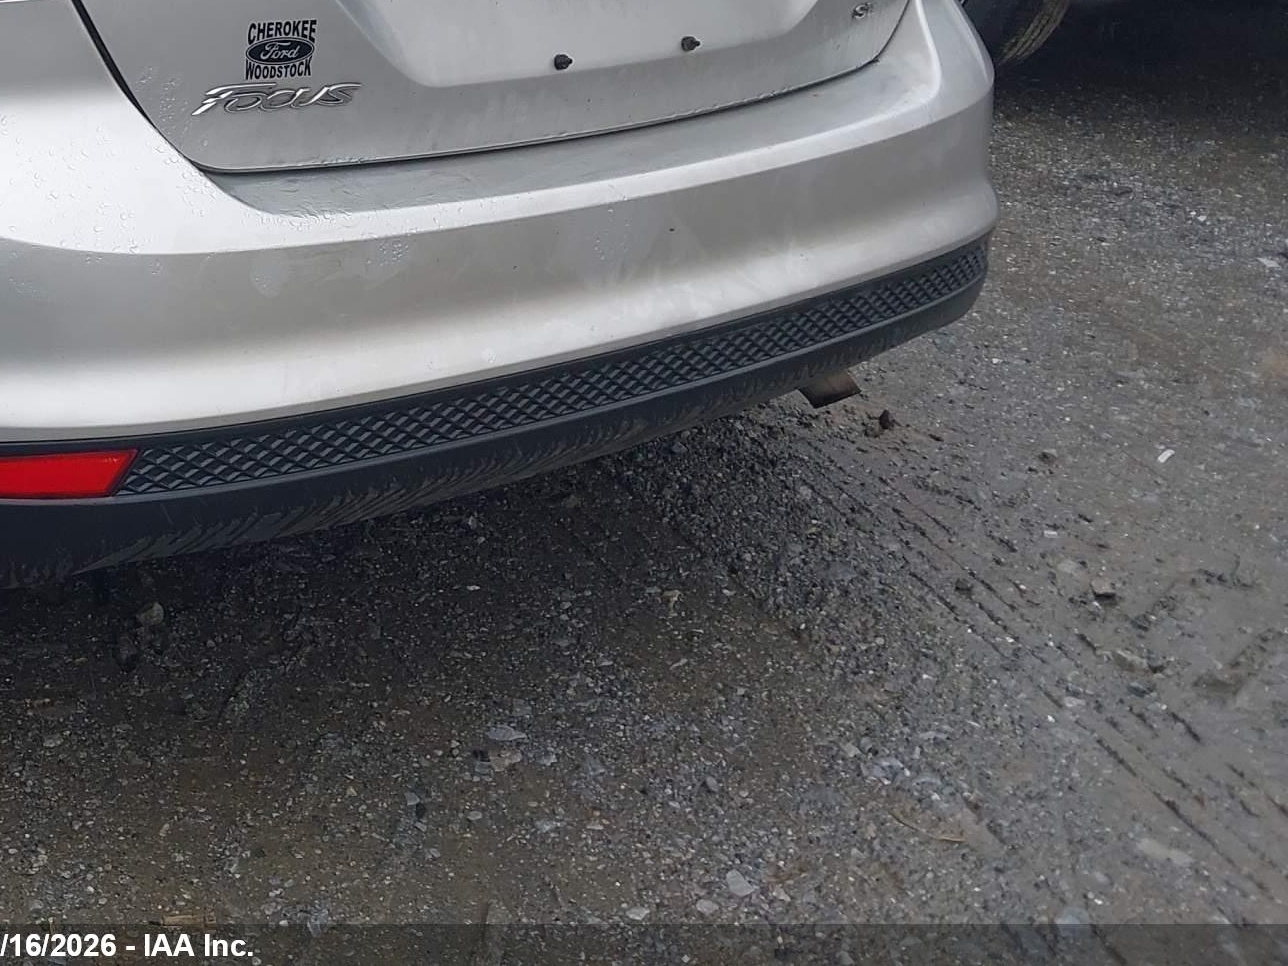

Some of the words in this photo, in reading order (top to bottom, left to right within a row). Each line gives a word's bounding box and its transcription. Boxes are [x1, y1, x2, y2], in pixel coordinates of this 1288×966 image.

[247, 19, 317, 45] CHEROKEE
[259, 41, 301, 60] Ford
[245, 56, 312, 81] WOODSTOCK
